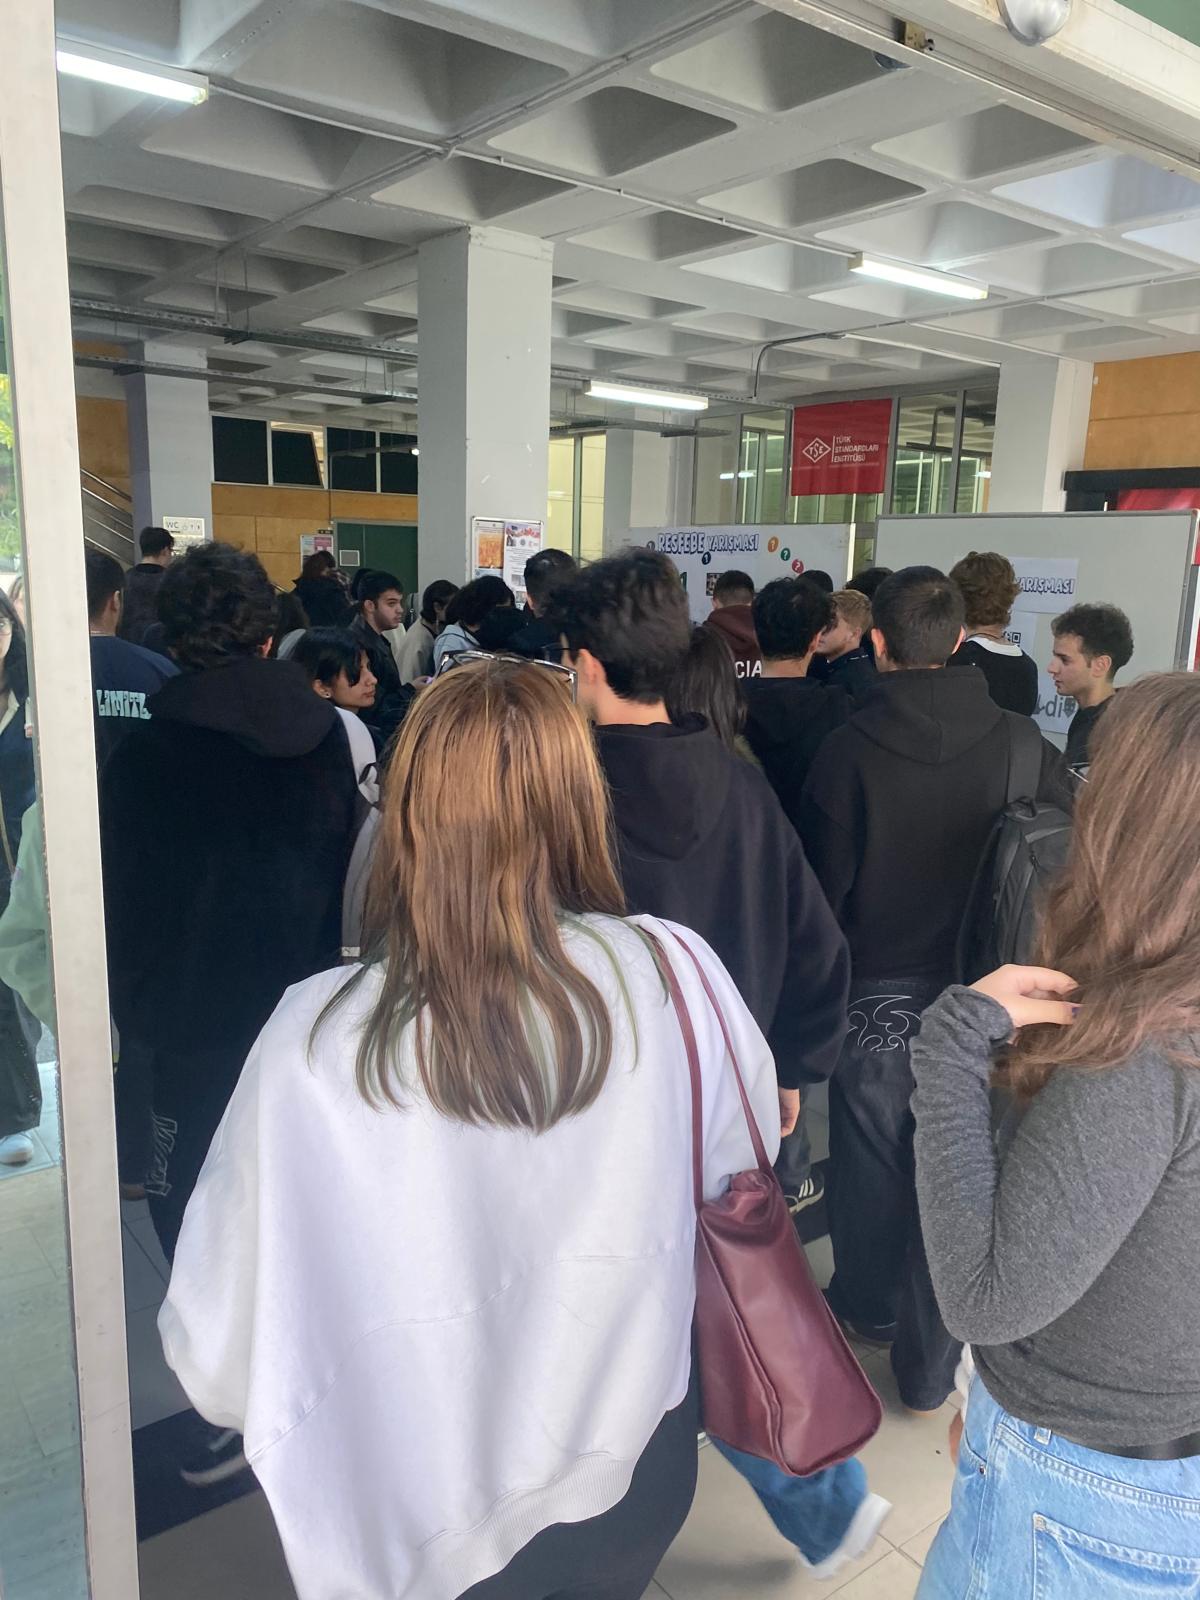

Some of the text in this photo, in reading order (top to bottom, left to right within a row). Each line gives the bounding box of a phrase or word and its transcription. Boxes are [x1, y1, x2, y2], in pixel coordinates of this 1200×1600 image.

[809, 443, 823, 458] TSE
[167, 521, 179, 529] WC
[658, 532, 759, 554] RESFEBE YARIŞMASI
